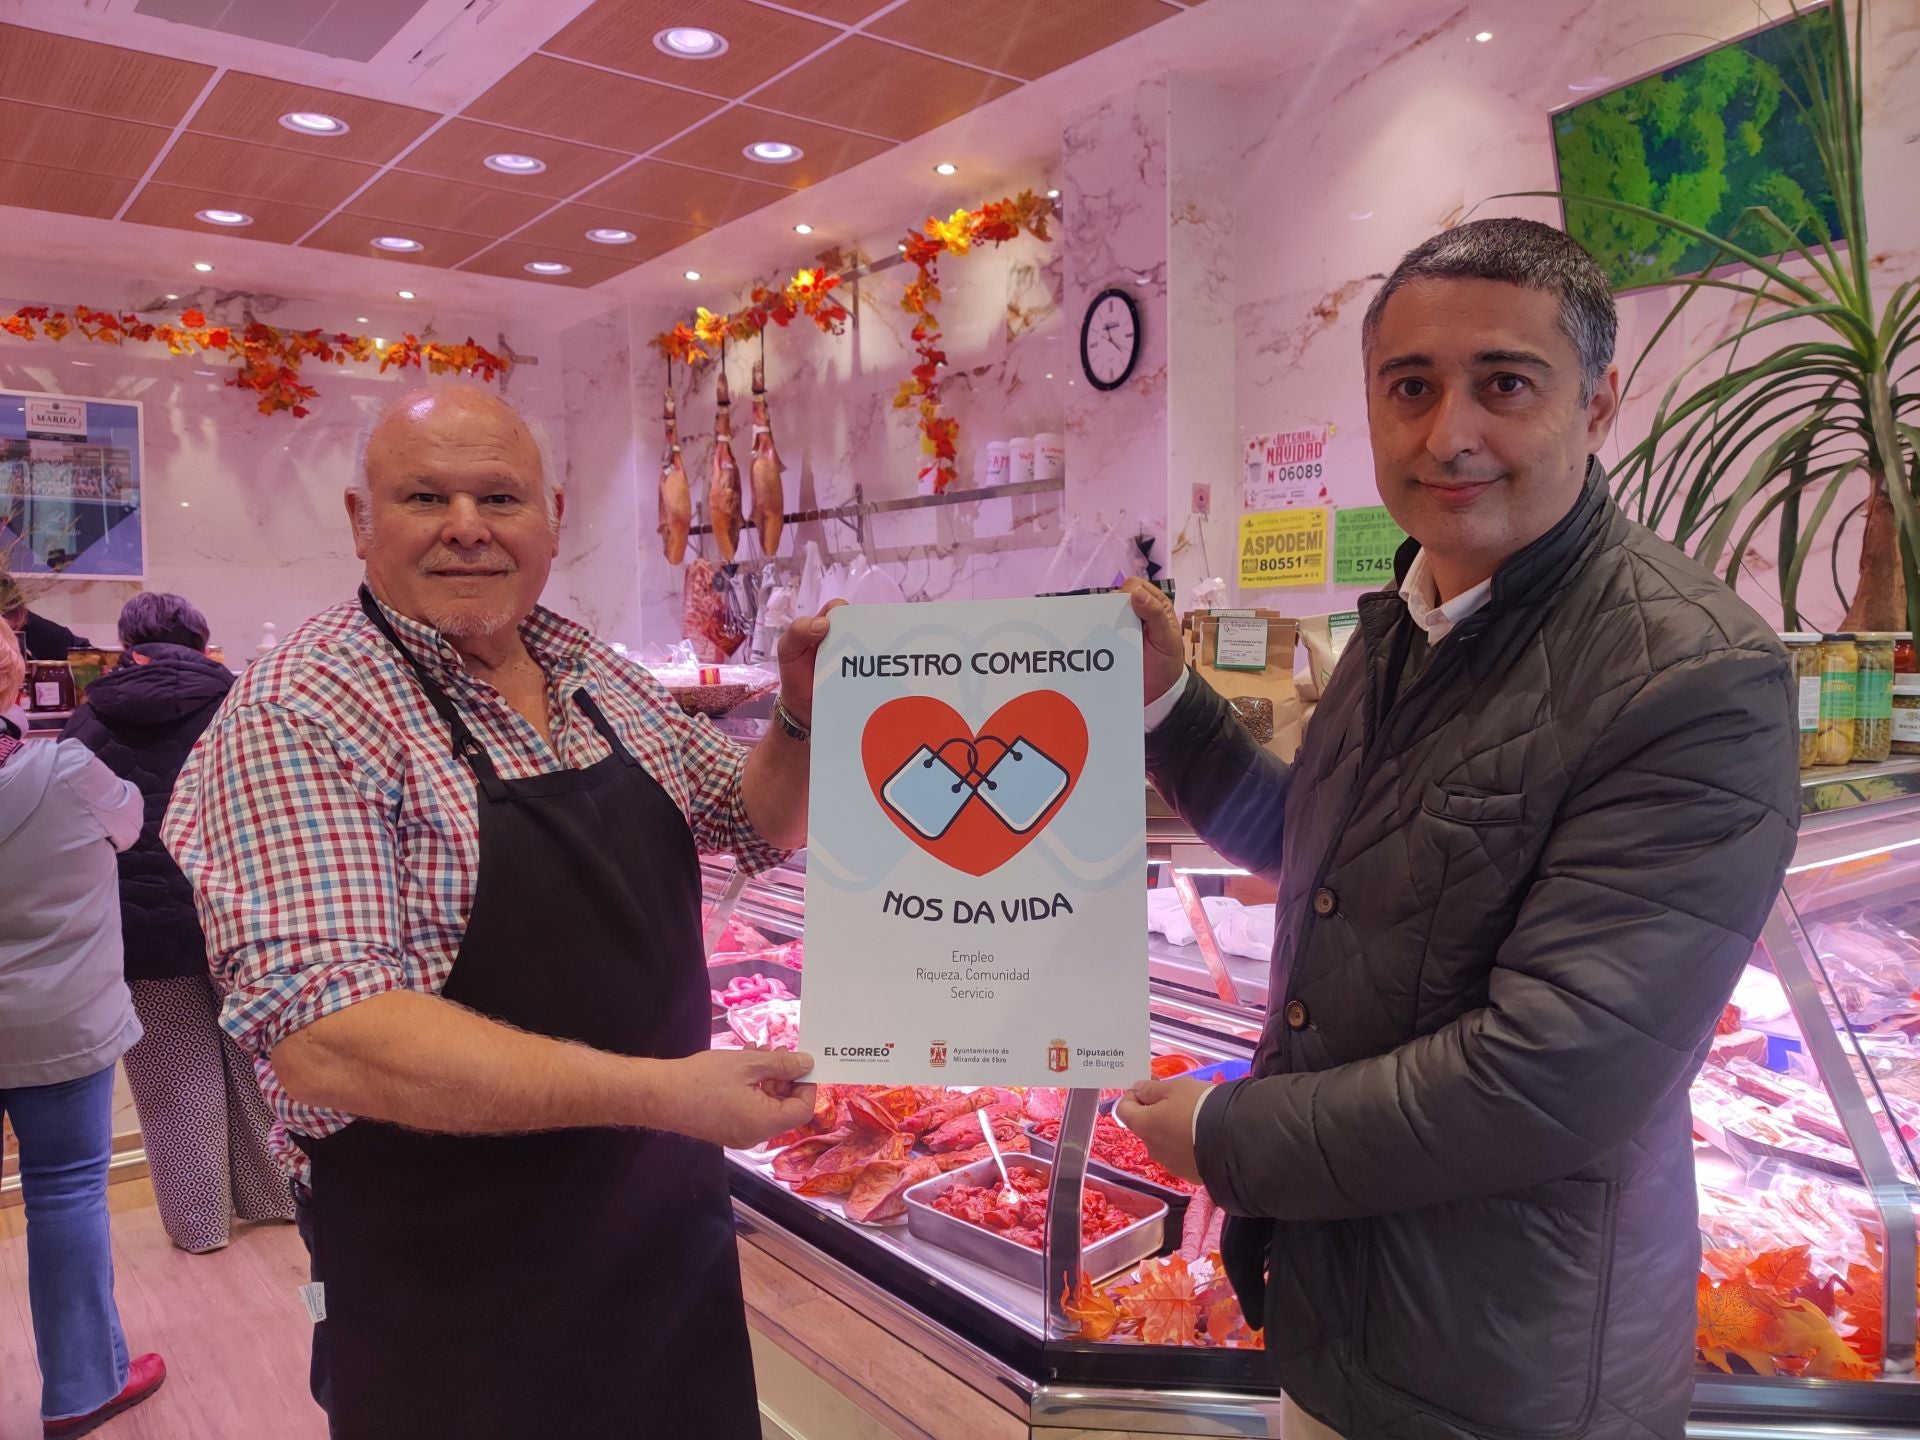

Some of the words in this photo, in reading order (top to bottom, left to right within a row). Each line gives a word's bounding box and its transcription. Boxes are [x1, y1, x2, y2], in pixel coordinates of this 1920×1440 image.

[1267, 441, 1322, 466] NAVIDAD
[1279, 463, 1323, 482] 06089
[1242, 530, 1323, 556] ASPODEMI
[1260, 556, 1301, 571] 80551
[1356, 558, 1392, 572] 5745
[841, 653, 962, 678] NUESTRO
[970, 648, 1115, 675] COMERCIO
[882, 890, 943, 922] NOS
[953, 900, 995, 924] DA
[1000, 892, 1074, 923] VIDA
[952, 950, 995, 965] Empleo
[916, 968, 962, 983] Riqueza,
[965, 968, 1030, 981] Comunidad
[950, 986, 995, 999] Servicio
[824, 1047, 838, 1056] EL
[840, 1047, 890, 1057] CORREO
[953, 1047, 999, 1055] Ayuntamiento
[1076, 1048, 1124, 1058] Diputación
[1082, 1059, 1093, 1067] de
[1095, 1059, 1125, 1069] Burgos
